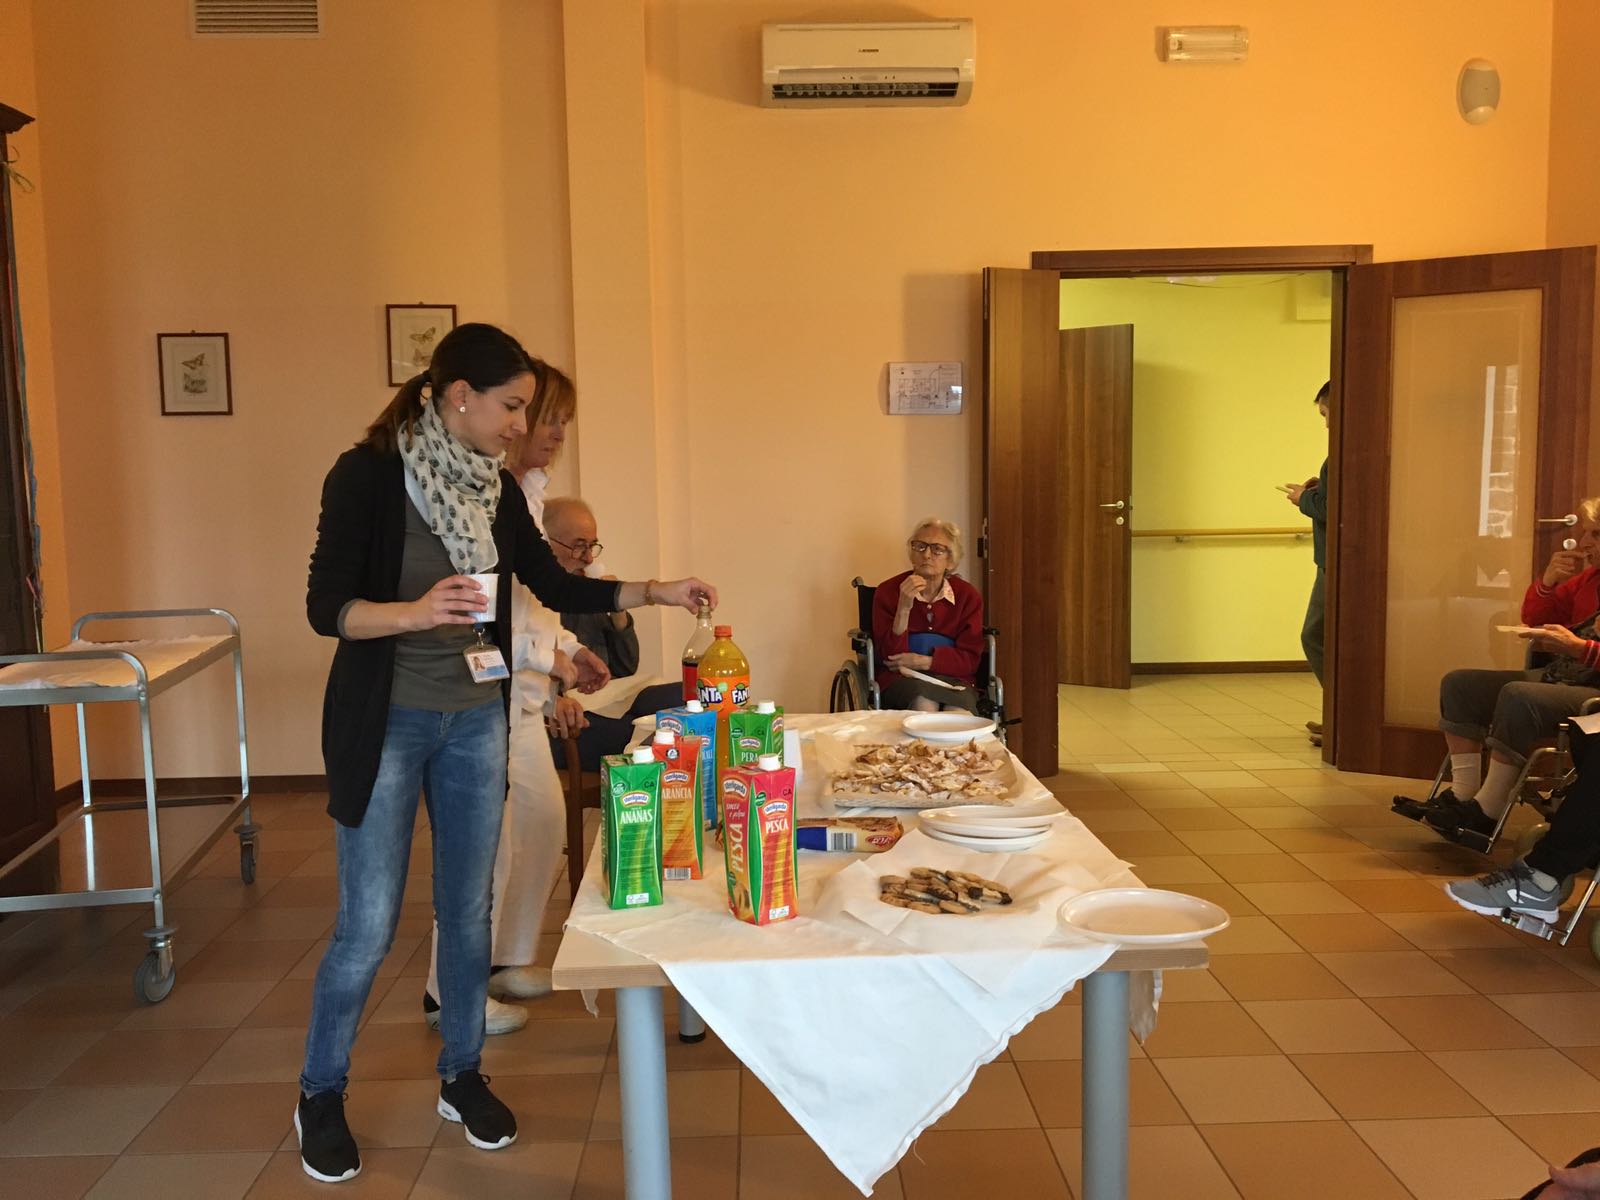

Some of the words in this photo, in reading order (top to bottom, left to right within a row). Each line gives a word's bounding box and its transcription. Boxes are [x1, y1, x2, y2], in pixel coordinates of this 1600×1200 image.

[662, 786, 692, 799] ARANCIA
[620, 808, 653, 825] ANANAS
[765, 817, 789, 834] PESCA
[729, 822, 744, 873] PESCA
